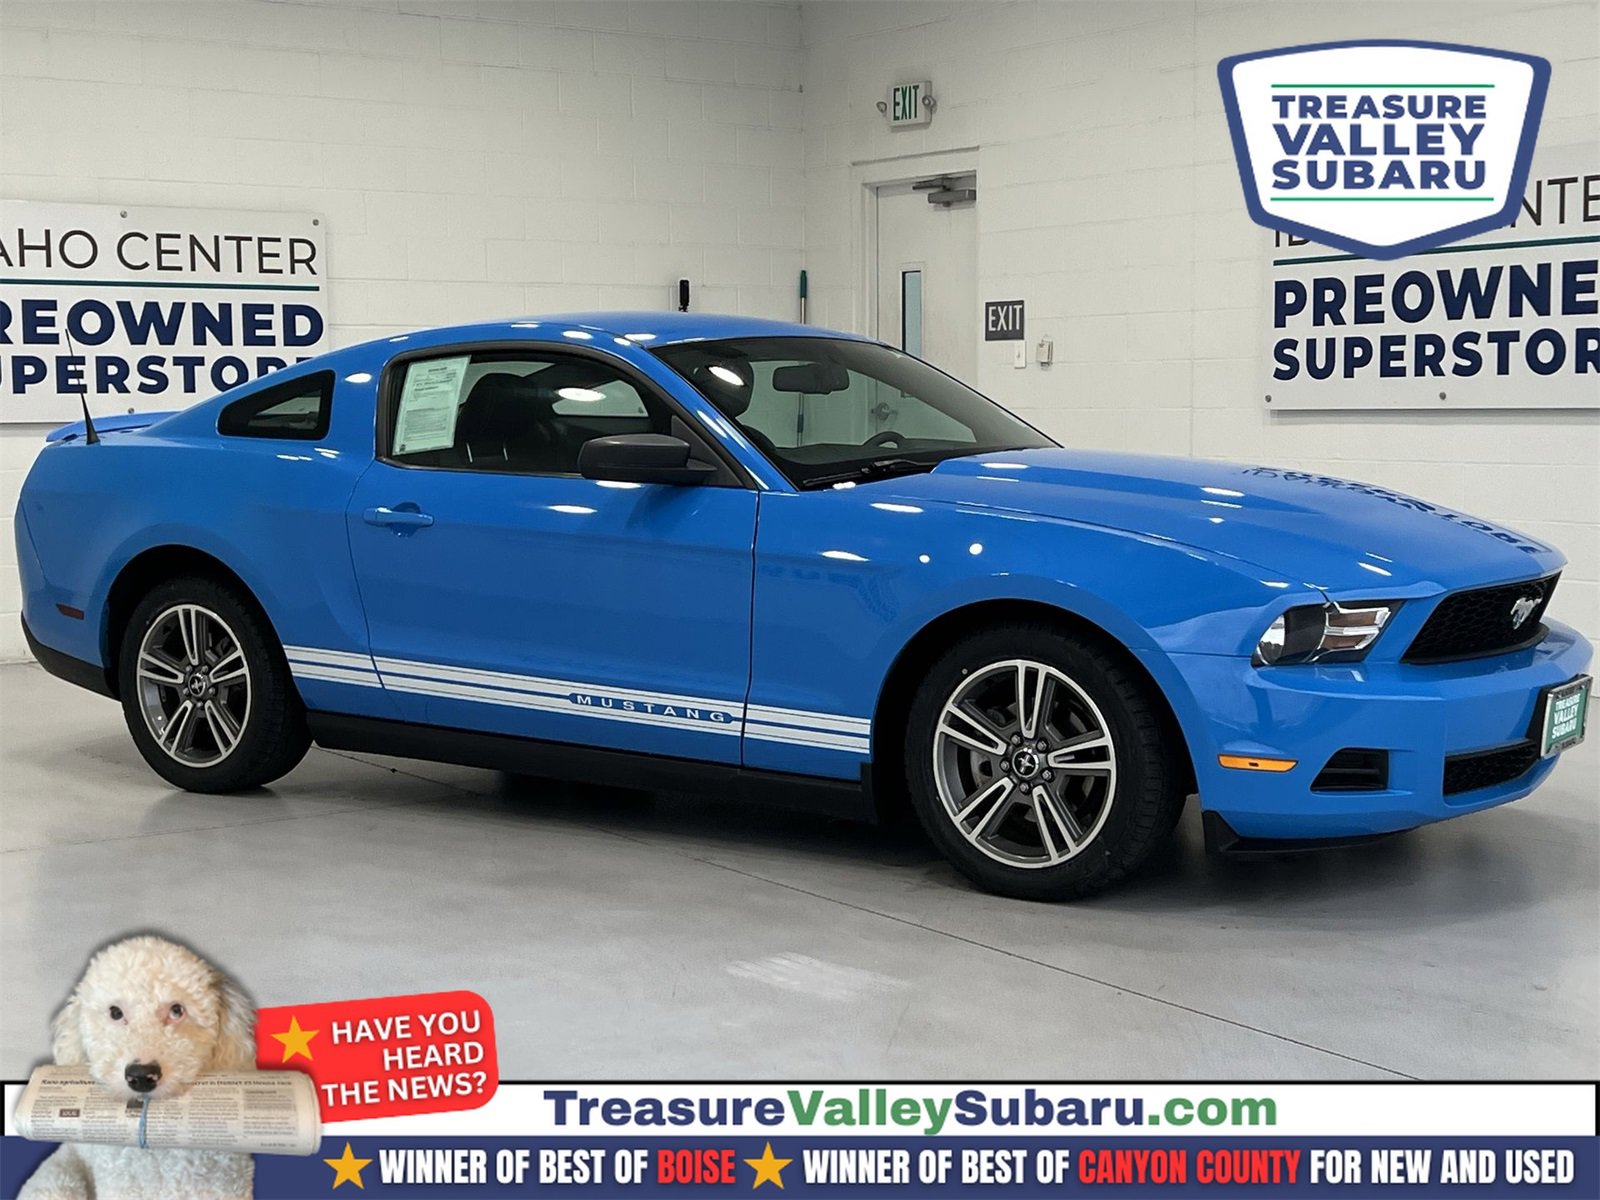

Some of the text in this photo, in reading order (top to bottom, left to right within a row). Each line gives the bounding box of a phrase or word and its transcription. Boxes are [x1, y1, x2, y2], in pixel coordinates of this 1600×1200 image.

[893, 84, 919, 121] EXIT
[117, 231, 318, 275] CENTER
[1274, 260, 1599, 329] PREOWNE
[988, 305, 1022, 331] EXIT
[1273, 327, 1600, 381] SUPERSTOR
[577, 695, 725, 722] MUSTANG
[1553, 704, 1579, 725] VALLEY
[1555, 693, 1580, 712] TREASURE
[1551, 717, 1577, 739] SUBARU
